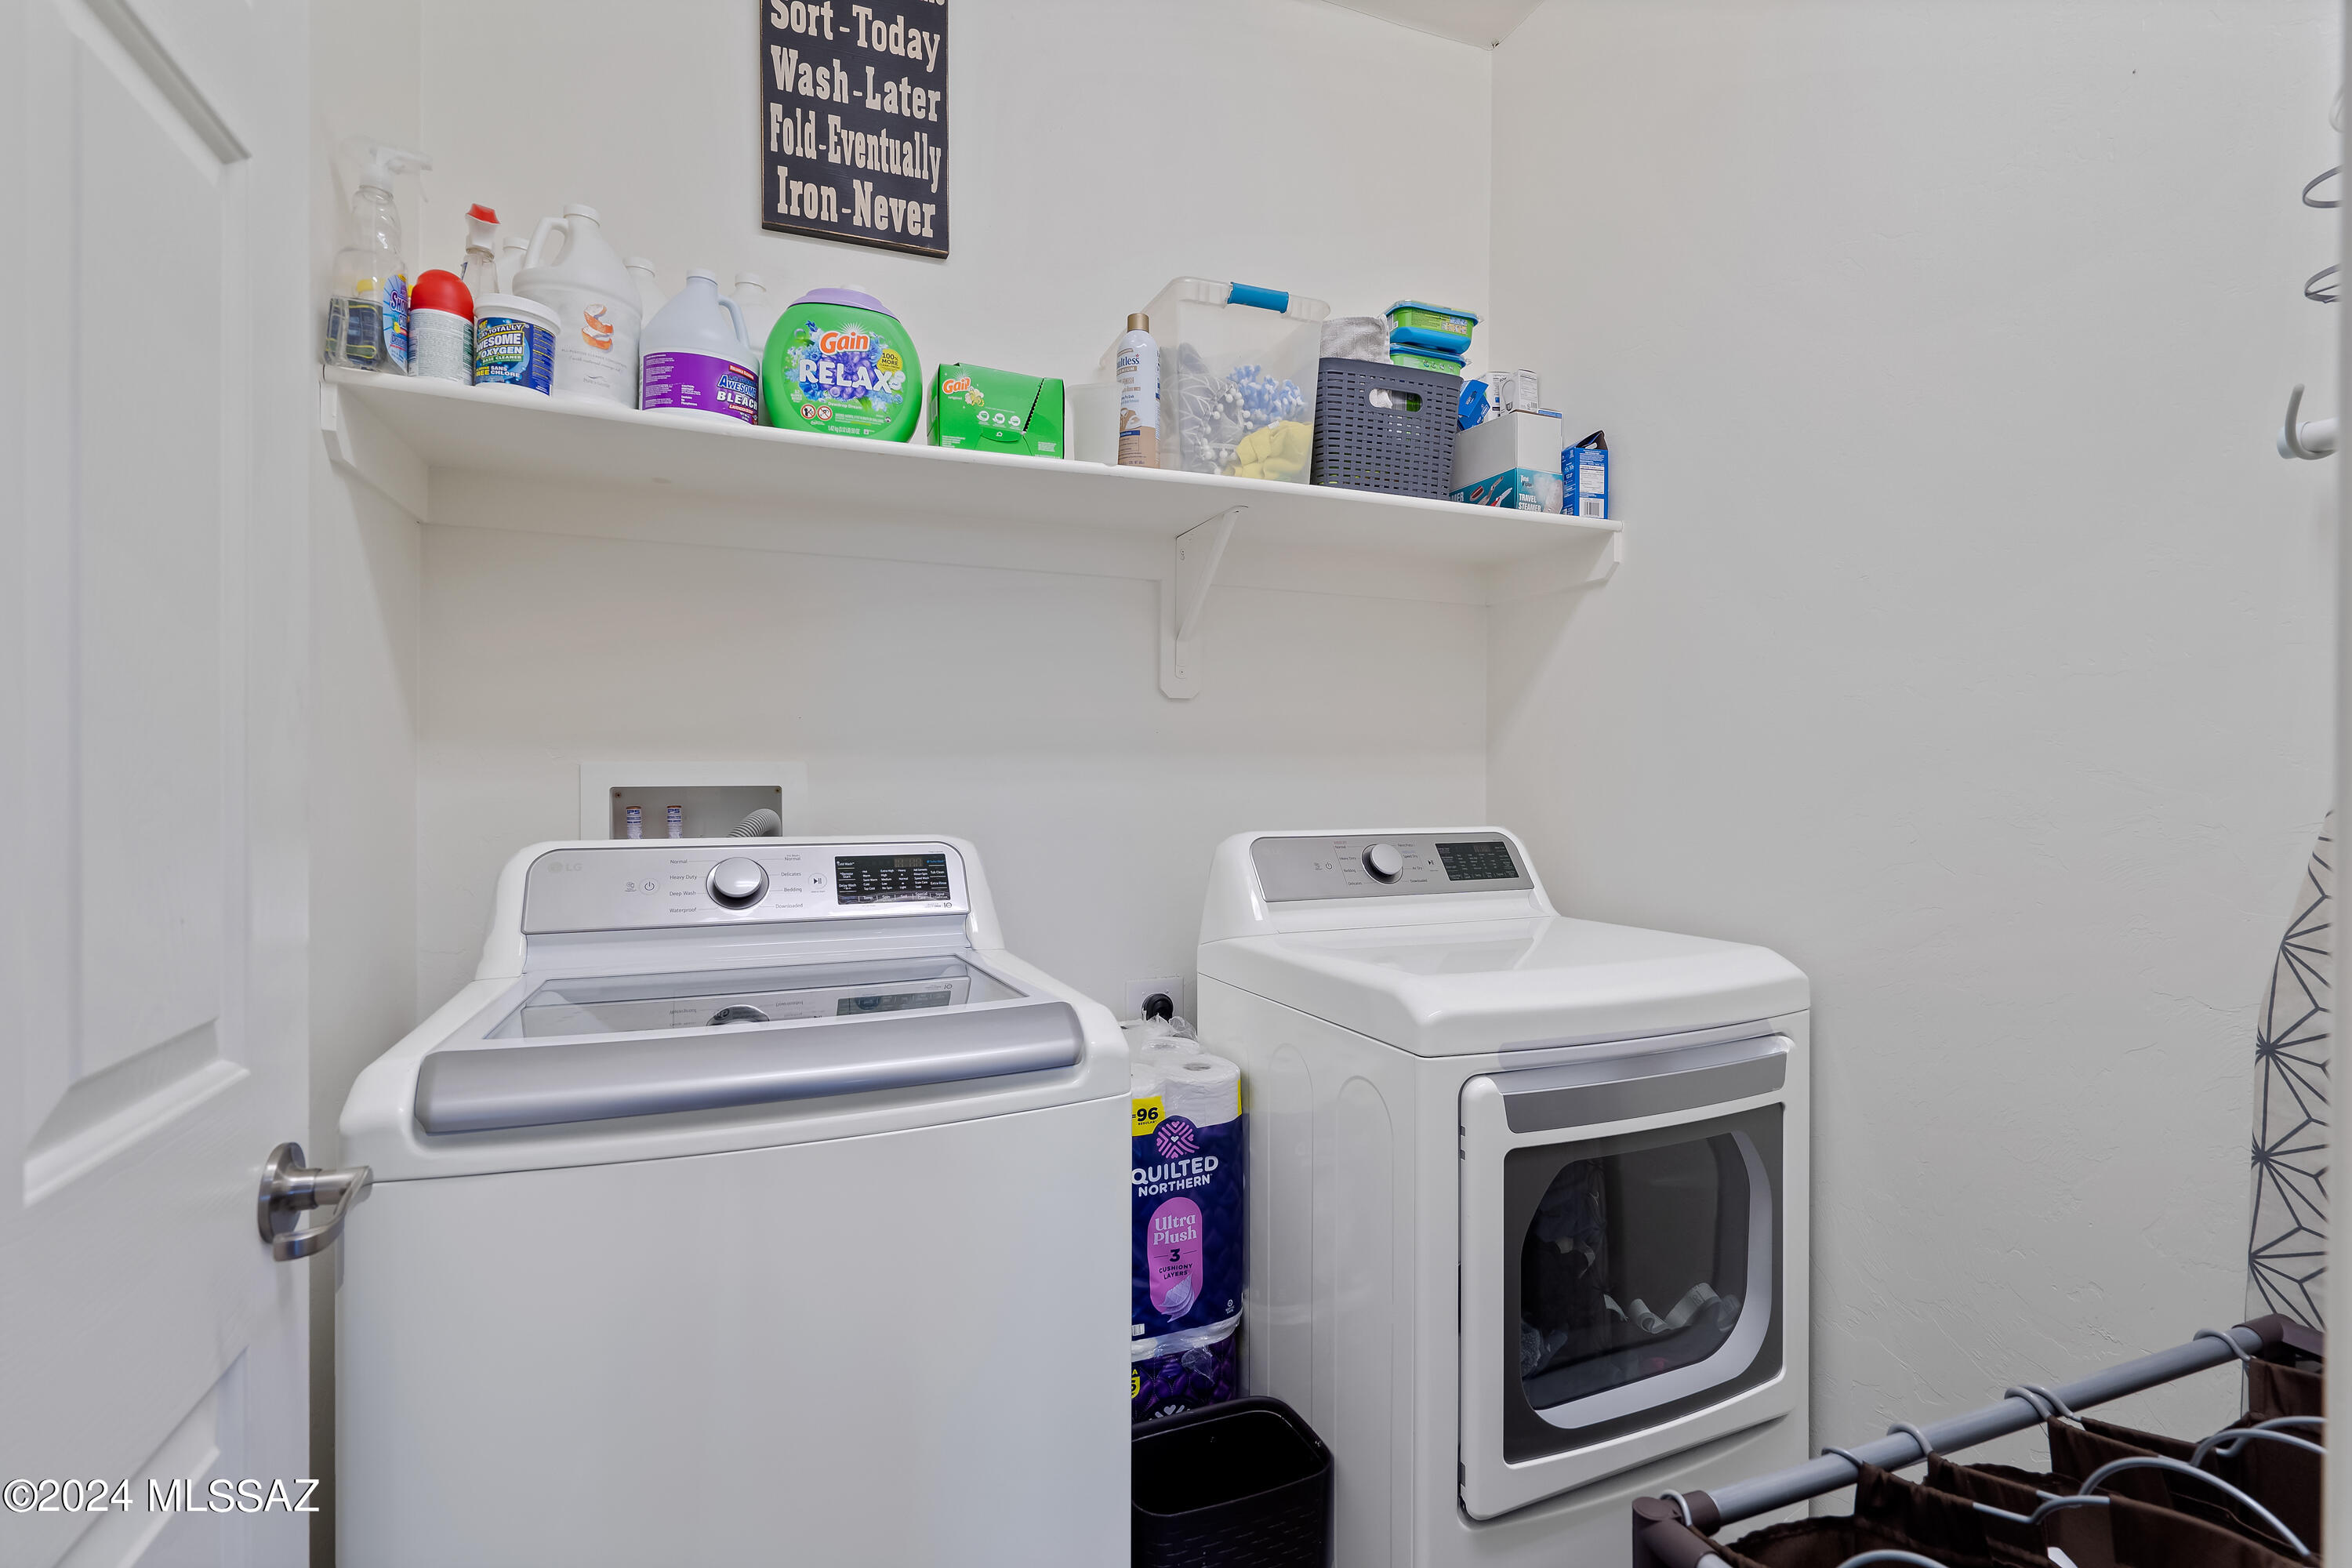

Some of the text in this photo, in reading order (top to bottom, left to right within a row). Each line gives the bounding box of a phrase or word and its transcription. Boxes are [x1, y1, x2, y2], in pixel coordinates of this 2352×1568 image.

[488, 324, 522, 334] TOTALLY
[477, 333, 521, 352] WESOME
[820, 332, 869, 355] Gain
[481, 347, 523, 358] OXYGEN
[798, 359, 892, 394] RELAX
[717, 390, 758, 411] BLEACH
[1519, 493, 1537, 503] TRAVEL
[1518, 503, 1541, 513] STEAMER
[565, 863, 583, 872] LG
[1132, 1156, 1219, 1185] QUILTED
[1138, 1174, 1211, 1197] NORTHERN
[1155, 1214, 1196, 1232] Ultra
[1153, 1226, 1197, 1246] Plush
[1169, 1248, 1181, 1262] 3
[1159, 1263, 1193, 1274] CUSHIONY
[1163, 1270, 1189, 1279] LAYERS
